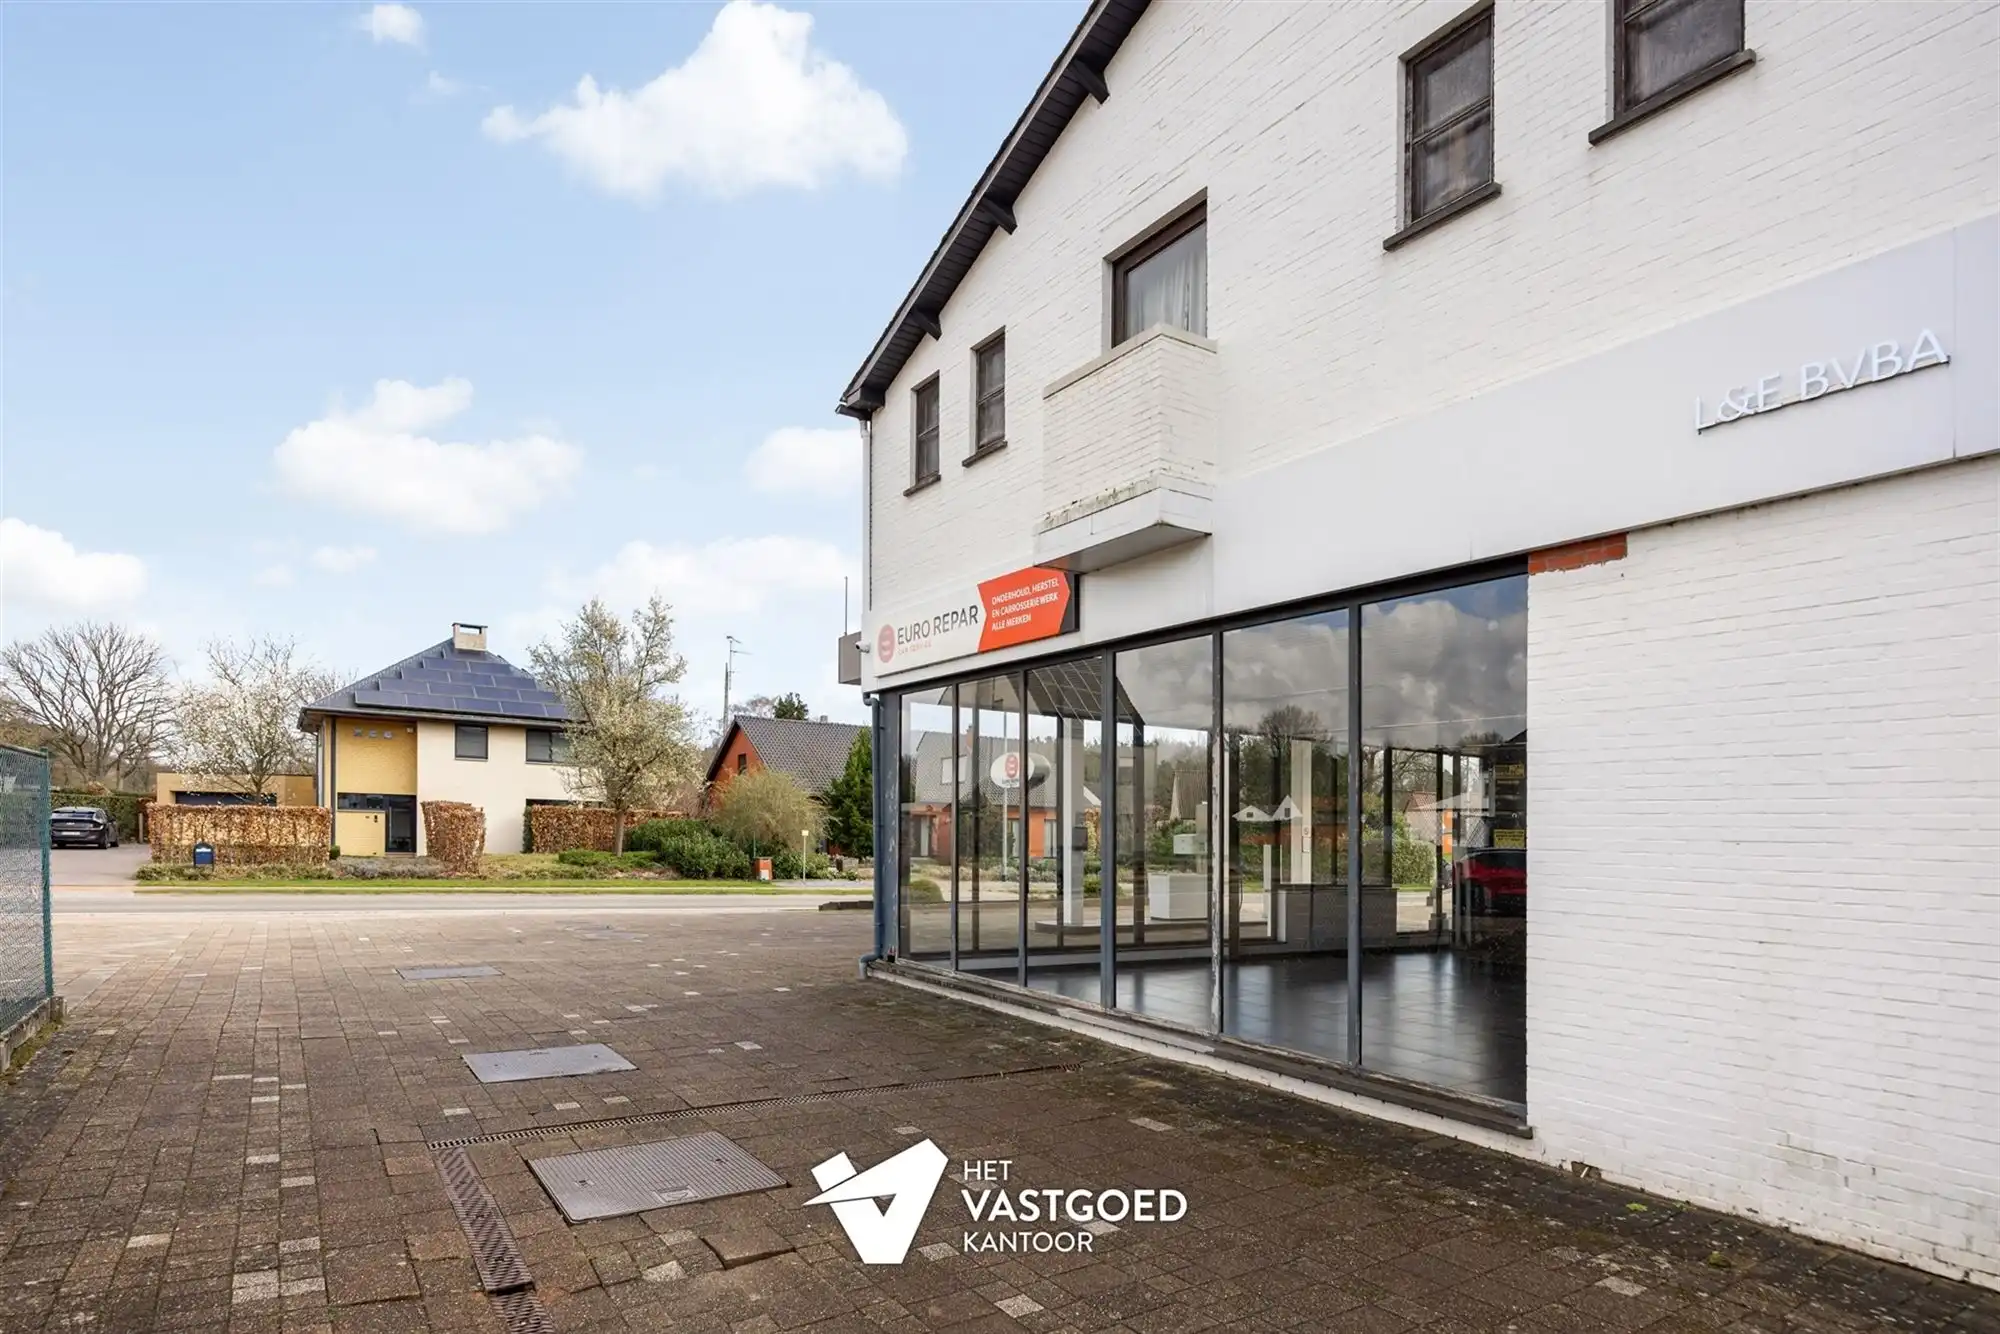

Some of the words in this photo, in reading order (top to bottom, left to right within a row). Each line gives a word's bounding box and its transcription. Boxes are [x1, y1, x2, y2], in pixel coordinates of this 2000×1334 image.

[1695, 371, 1782, 430] L&E
[1799, 327, 1950, 400] BVBA
[992, 586, 1031, 605] ONDERHOUD,
[1032, 578, 1060, 592] HERSTEL
[897, 621, 930, 645] EURO
[933, 605, 979, 636] REPAR
[992, 608, 1000, 618] EN
[992, 619, 1005, 631] ALLE
[1006, 614, 1032, 627] MERKEN
